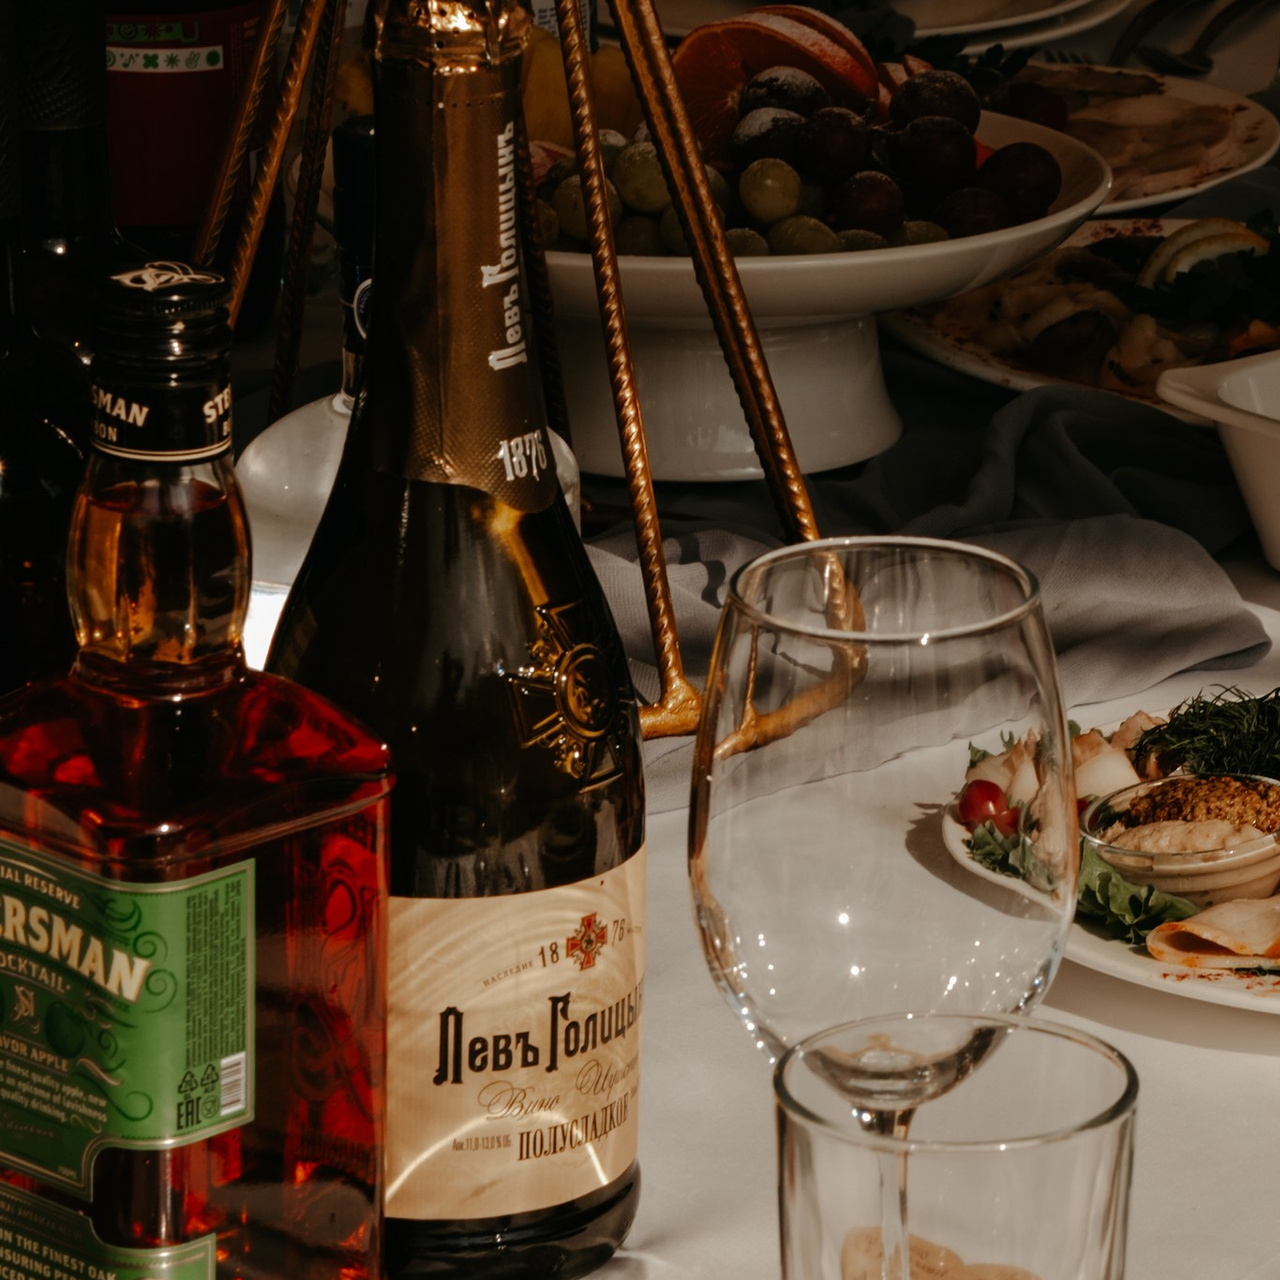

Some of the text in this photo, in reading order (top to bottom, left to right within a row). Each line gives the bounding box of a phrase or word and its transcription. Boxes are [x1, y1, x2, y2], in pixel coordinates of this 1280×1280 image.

[480, 121, 527, 371] Левъ Голицынъ
[498, 428, 547, 482] 1876
[24, 872, 80, 910] RESERVE
[0, 893, 152, 1002] RSMAN
[612, 917, 627, 948] 76
[538, 941, 560, 968] 18
[30, 1047, 69, 1073] APPLE
[433, 1006, 540, 1086] Левъ
[477, 1080, 561, 1121] Вино
[517, 1092, 630, 1161] ПОЛУСЛАДКОЕ
[15, 1234, 40, 1255] THE
[42, 1245, 86, 1275] FINEST
